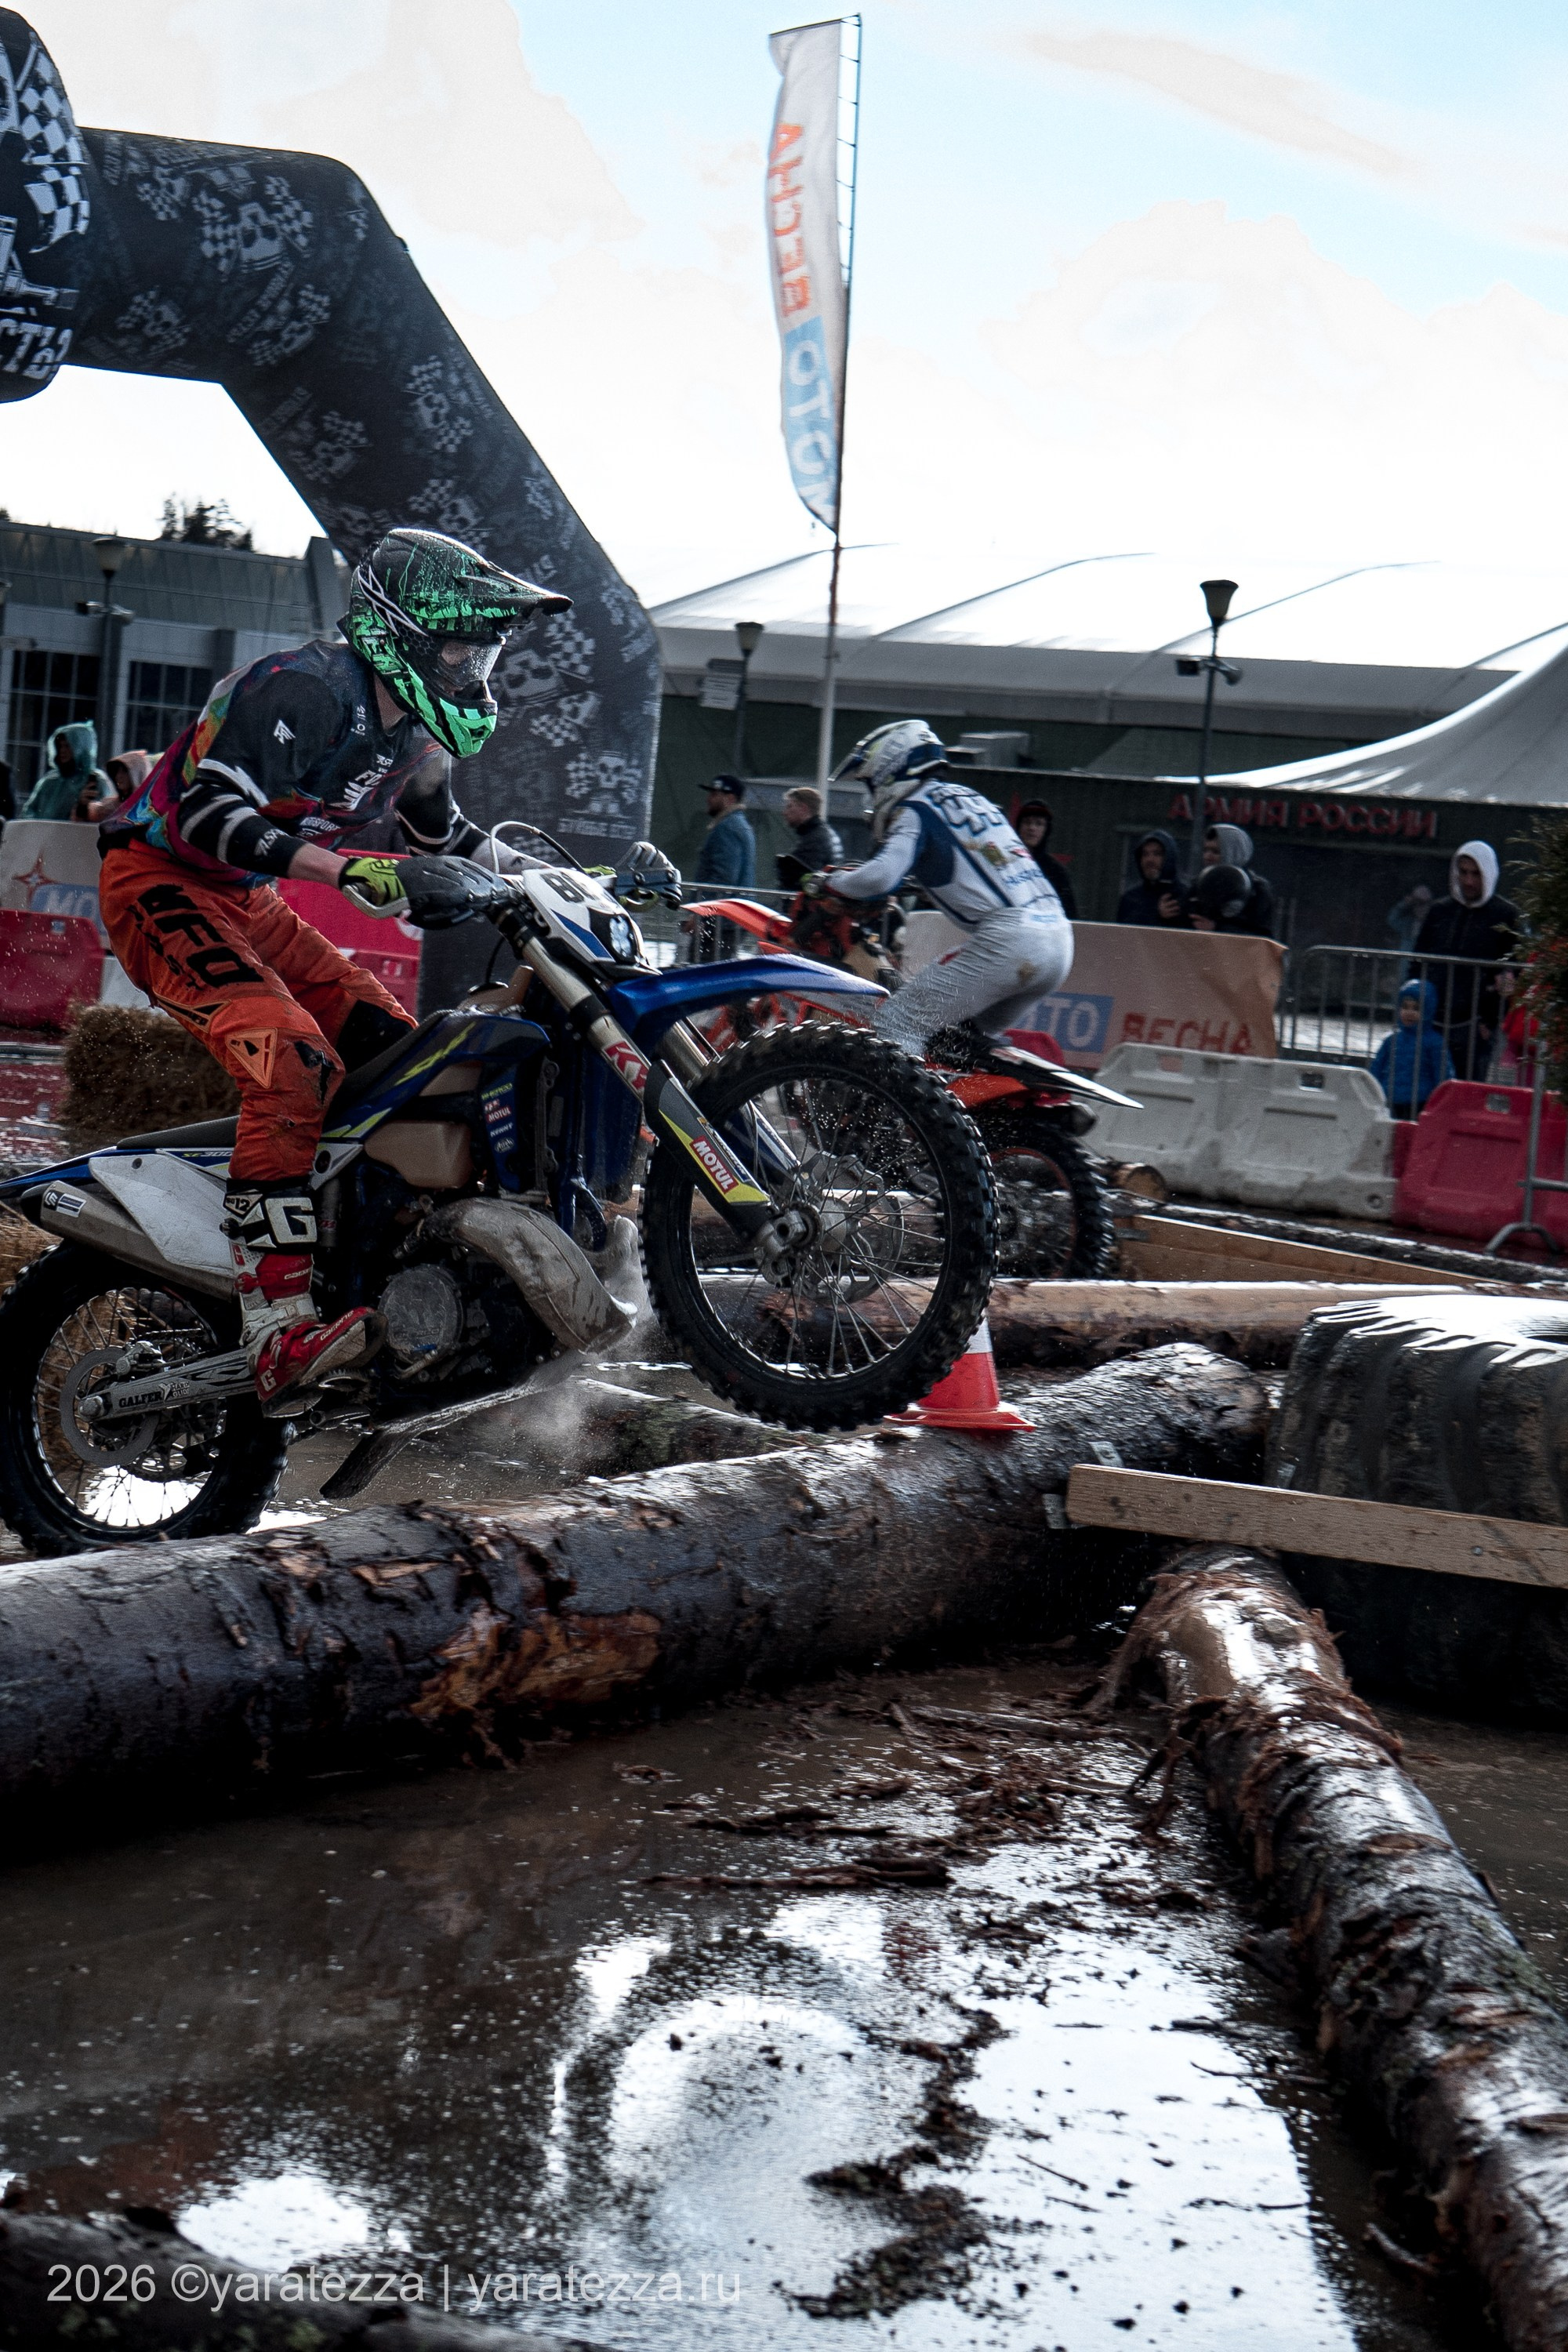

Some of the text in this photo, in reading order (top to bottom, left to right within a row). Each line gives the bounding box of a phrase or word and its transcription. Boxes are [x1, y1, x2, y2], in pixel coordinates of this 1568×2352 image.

[1297, 801, 1439, 839] РОССИИ
[488, 1107, 511, 1122] MOTUL
[693, 1139, 735, 1191] MOTUL
[119, 1391, 162, 1408] GALFER
